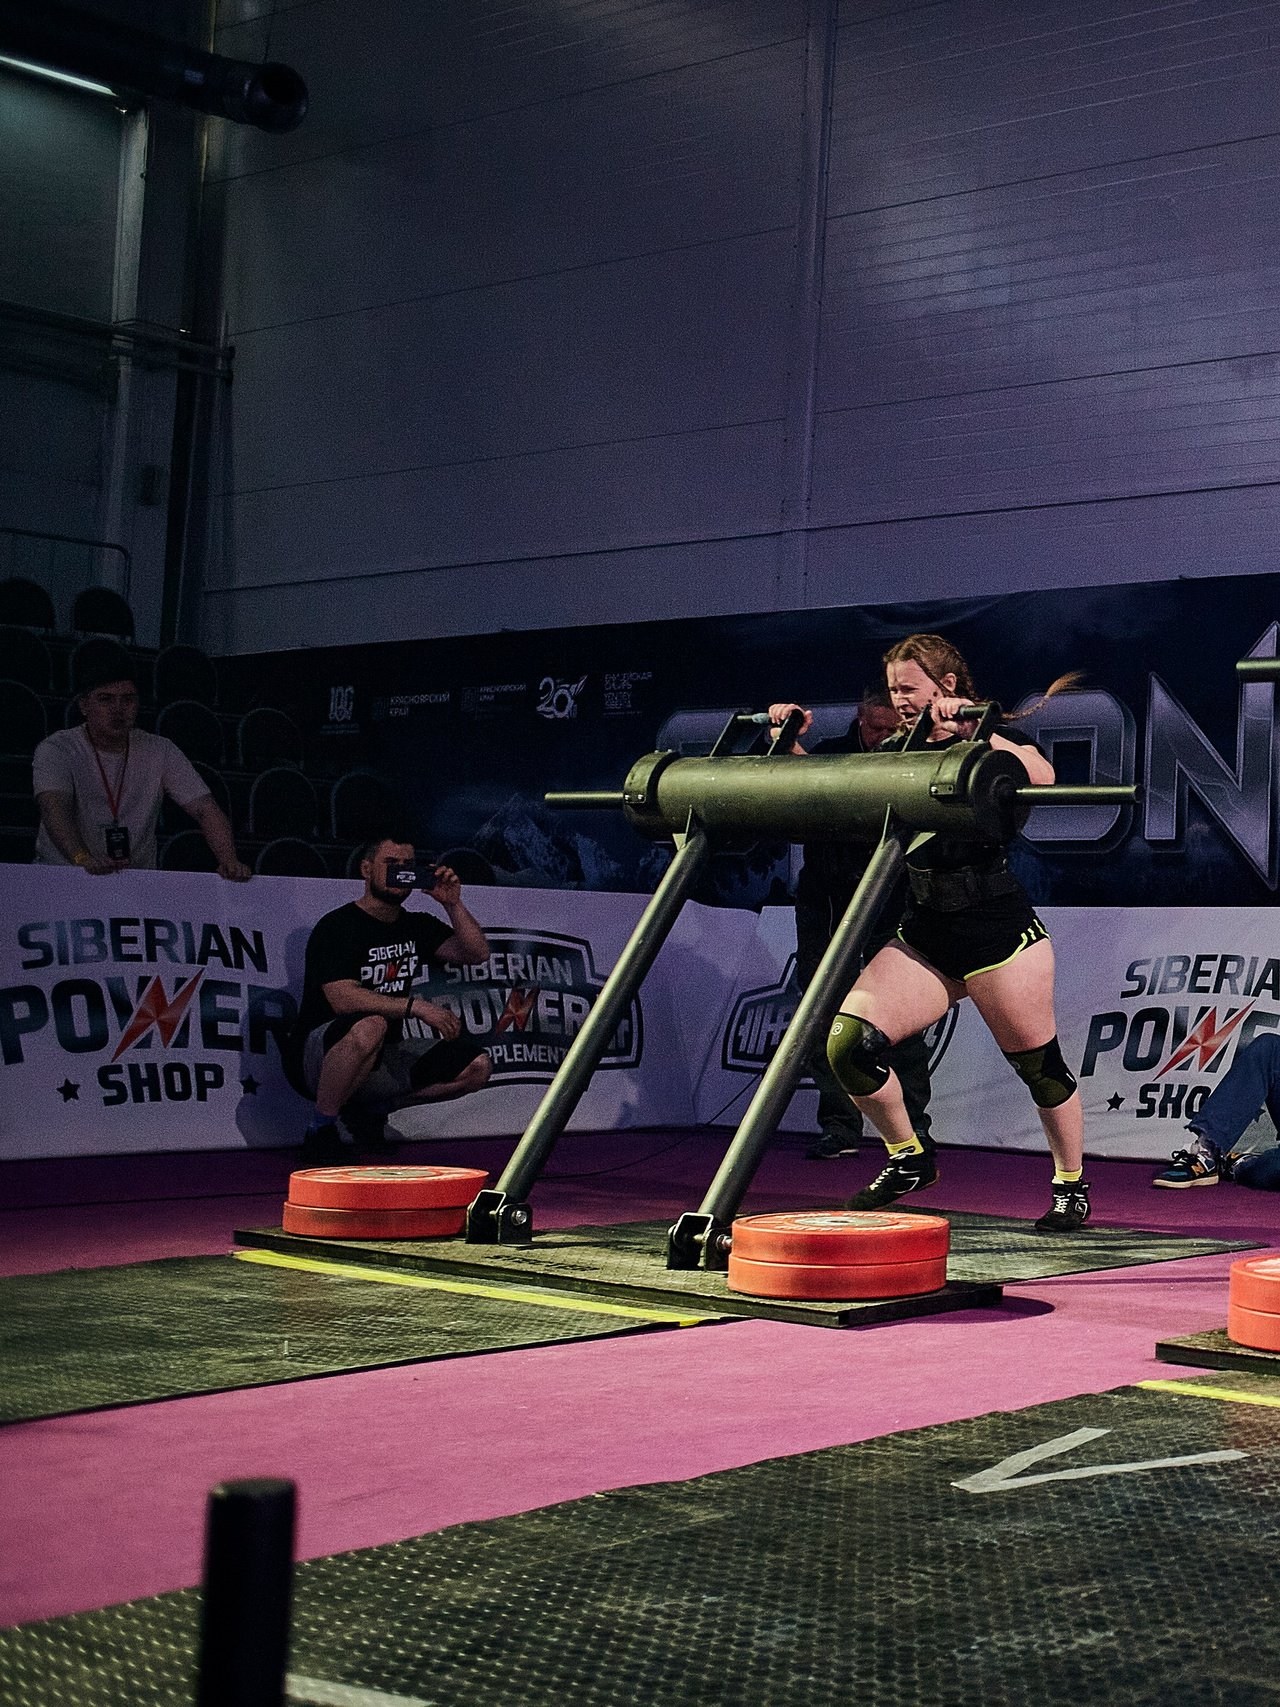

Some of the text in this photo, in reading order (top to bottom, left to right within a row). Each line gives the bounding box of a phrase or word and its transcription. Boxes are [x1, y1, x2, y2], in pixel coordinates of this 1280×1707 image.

[17, 917, 269, 973] SIBERIAN
[368, 940, 416, 962] SIBERIAN
[444, 952, 573, 986] SIBERIAN
[0, 975, 299, 1065] POWER
[97, 1062, 225, 1106] SHOP
[1136, 1083, 1212, 1119] SHO
